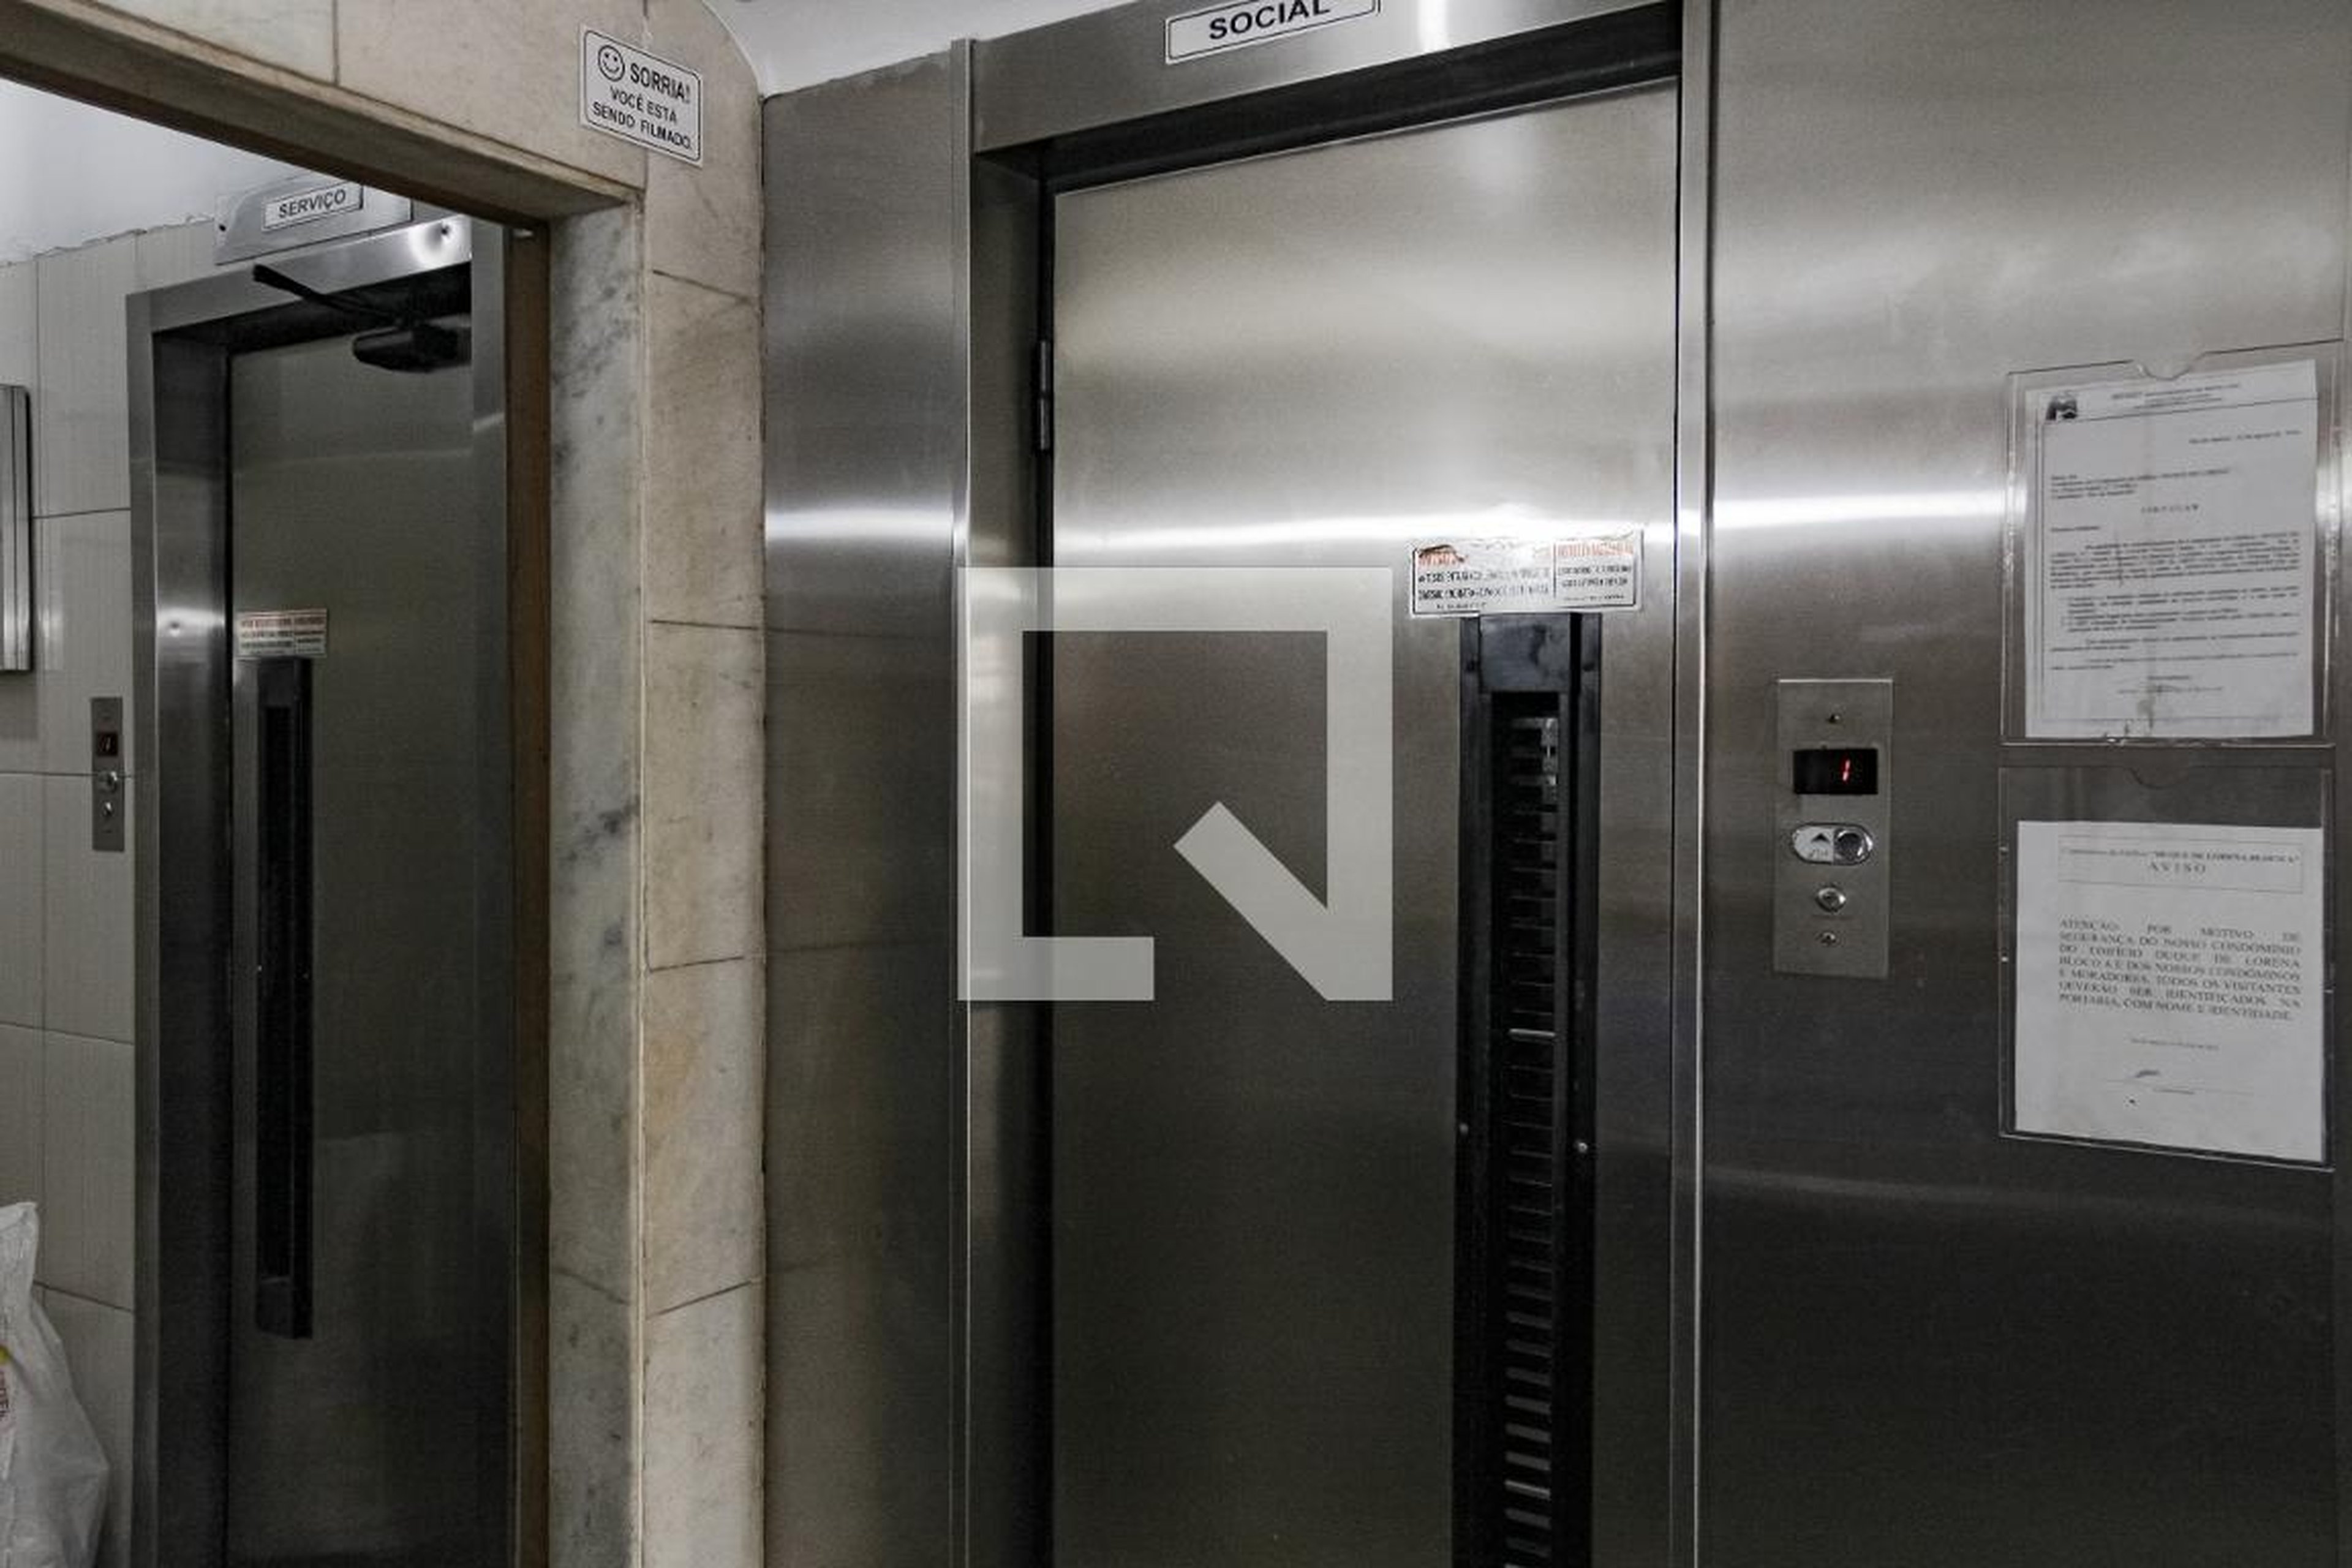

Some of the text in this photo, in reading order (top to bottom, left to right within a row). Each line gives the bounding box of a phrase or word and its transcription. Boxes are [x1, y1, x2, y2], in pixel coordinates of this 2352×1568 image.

[1208, 0, 1330, 40] SOCIAL
[630, 62, 691, 104] SORRIA!
[592, 101, 636, 128] SENDO
[279, 189, 347, 218] SERVIÇO
[1842, 758, 1851, 783] 1
